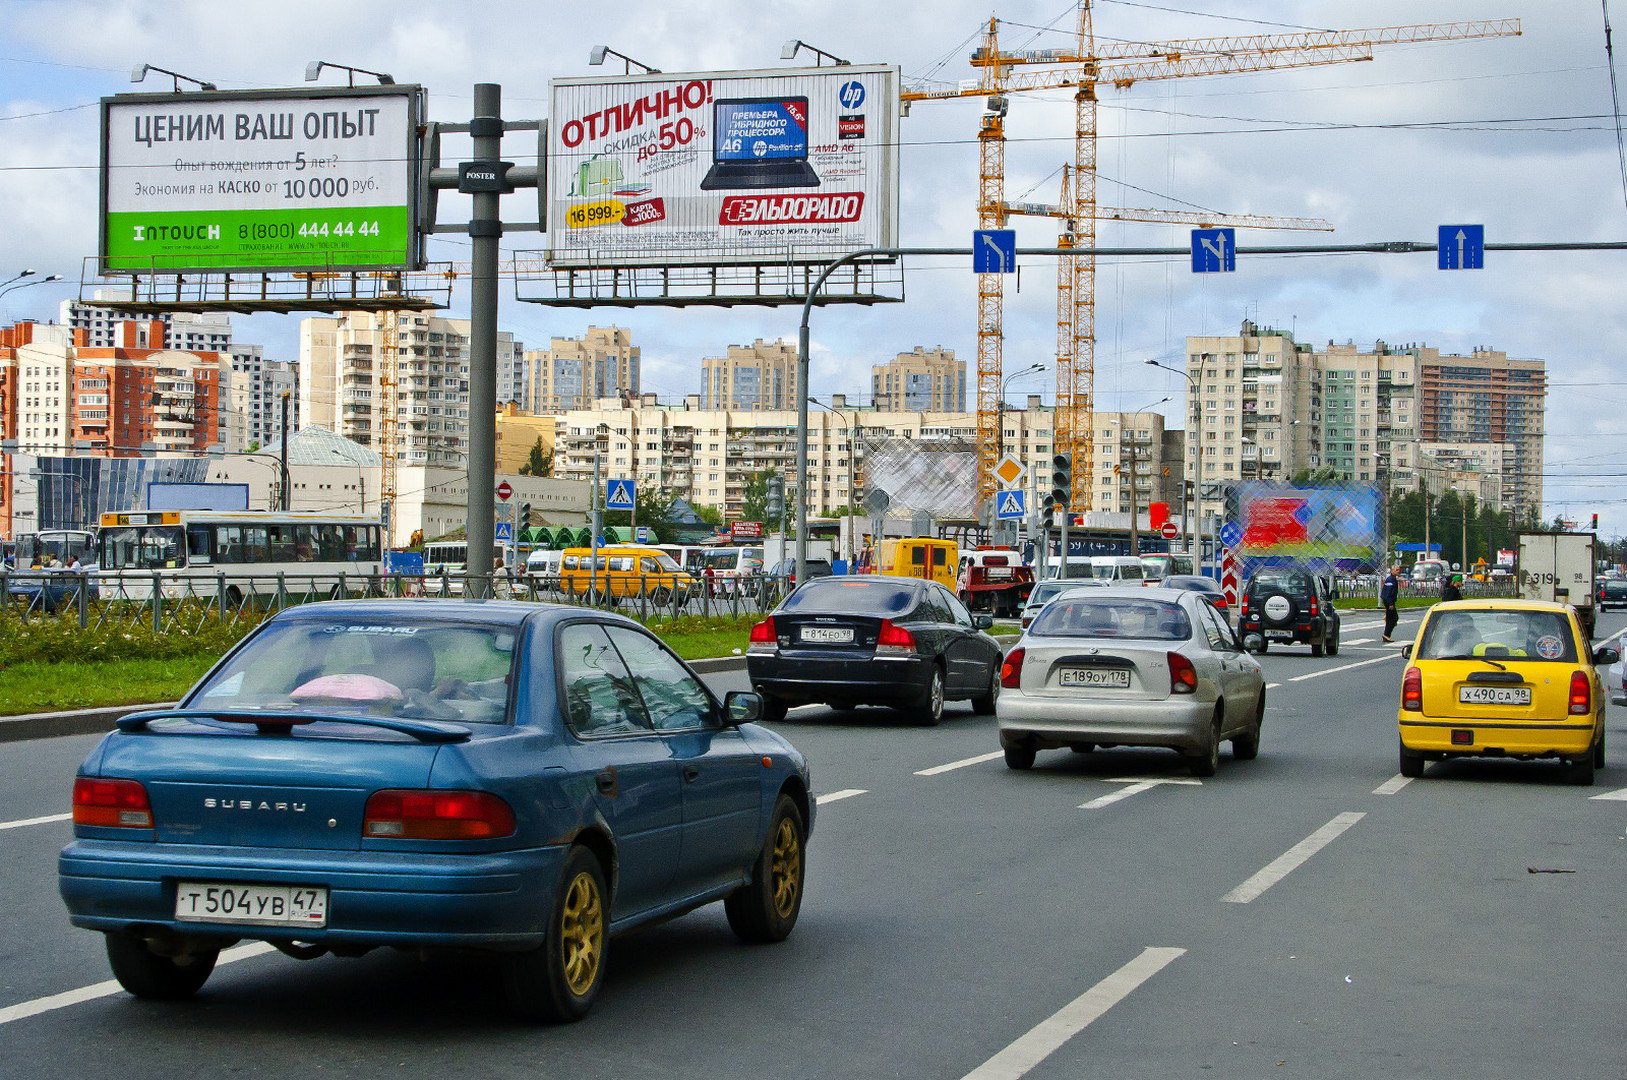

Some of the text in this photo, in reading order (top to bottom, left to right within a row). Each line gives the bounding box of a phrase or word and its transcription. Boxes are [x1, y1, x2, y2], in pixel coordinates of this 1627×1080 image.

[842, 80, 863, 109] hp
[562, 80, 713, 148] ОТЛИЧНО!
[732, 110, 778, 120] ПРЕМЬЕРА
[135, 109, 380, 148] ЦЕНИМ ВАШ ОПЫТ
[730, 119, 787, 129] ГИБРИДНОГО
[840, 123, 864, 132] VISION
[728, 128, 785, 138] ПРОЦЕССОРА
[604, 129, 657, 155] СКИДКА
[720, 139, 742, 153] A6
[637, 144, 657, 163] ДО
[815, 145, 838, 153] AMD
[175, 158, 205, 171] Опыт
[210, 161, 273, 173] вождения
[295, 152, 306, 171] 5
[310, 154, 338, 169] лет?
[466, 172, 496, 180] POSTER
[135, 182, 195, 196] Экономия
[200, 184, 213, 194] на
[218, 180, 260, 194] КАСКО
[265, 182, 278, 193] от
[353, 176, 379, 194] руб.
[630, 203, 654, 215] КАРТА
[239, 220, 380, 240] 8 (800) 444 44 44
[738, 226, 840, 238] Так просто жить лучше
[347, 625, 419, 634] SUBARU
[1109, 672, 1126, 681] 178
[1514, 689, 1527, 699] 98
[204, 798, 306, 812] SUBARU
[293, 890, 317, 910] 47
